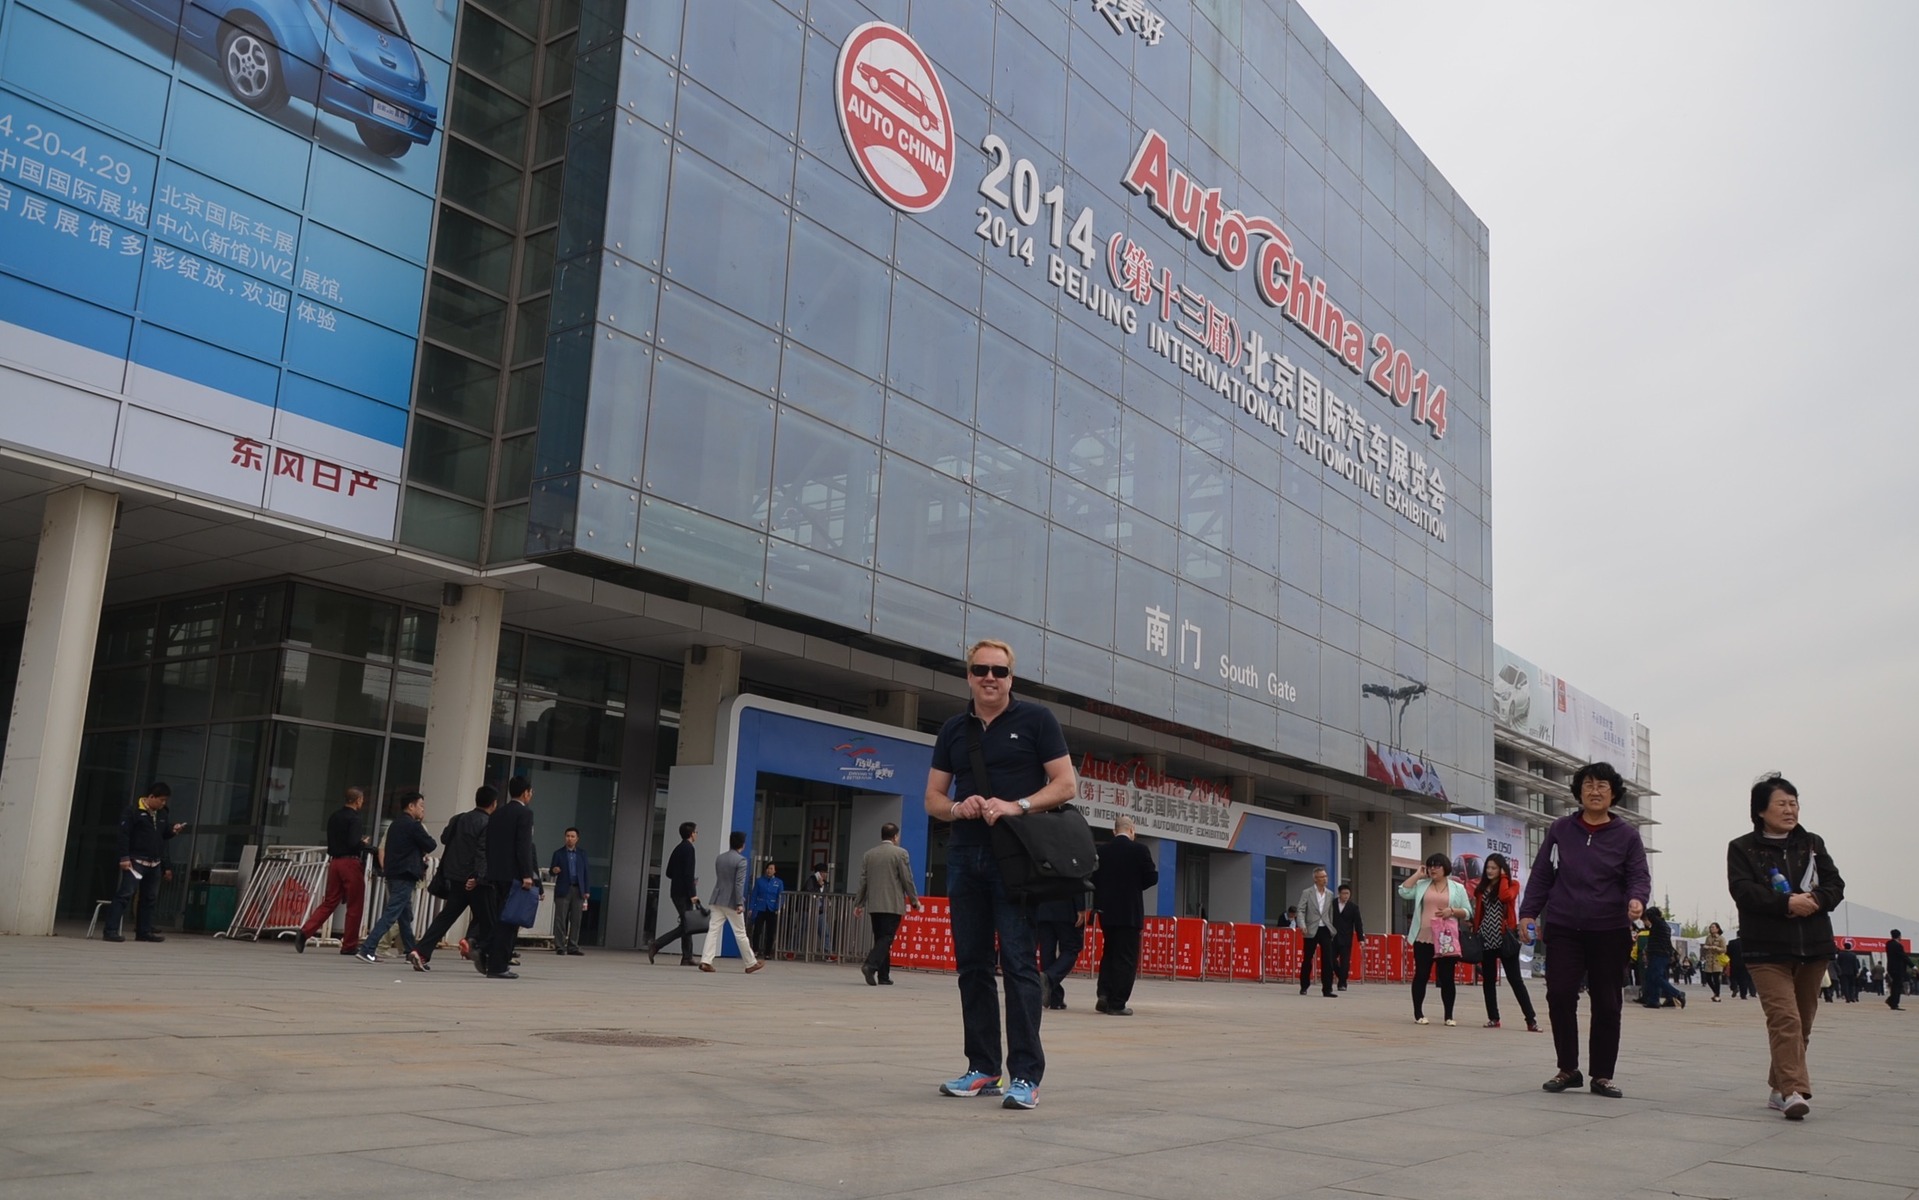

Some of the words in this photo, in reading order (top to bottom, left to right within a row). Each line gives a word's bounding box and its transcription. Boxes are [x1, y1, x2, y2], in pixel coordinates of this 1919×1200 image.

[847, 93, 893, 139] AUTO
[898, 128, 946, 178] CHINA
[1121, 129, 1249, 271] Auto
[1254, 239, 1365, 375] China
[1365, 333, 1448, 440] 2014
[975, 206, 1034, 267] 2014
[1048, 253, 1137, 334] BEIJING
[1148, 321, 1288, 437] INTERNATIONAL
[1294, 424, 1381, 499] AUTOMOTIVE
[1385, 484, 1447, 542] EXHIBITION
[231, 437, 378, 497] 东风日产
[1145, 605, 1201, 670] 南门
[1220, 654, 1259, 689] South
[1267, 672, 1297, 702] Gate
[1079, 752, 1129, 786] Auto
[1133, 763, 1186, 799] China
[1187, 776, 1233, 809] 2014
[1094, 808, 1149, 827] INTERNONAL
[1153, 821, 1193, 836] AUTOMOTIVE
[1196, 827, 1230, 841] EXHIBITION
[904, 915, 923, 923] Kindly
[912, 935, 939, 943] above
